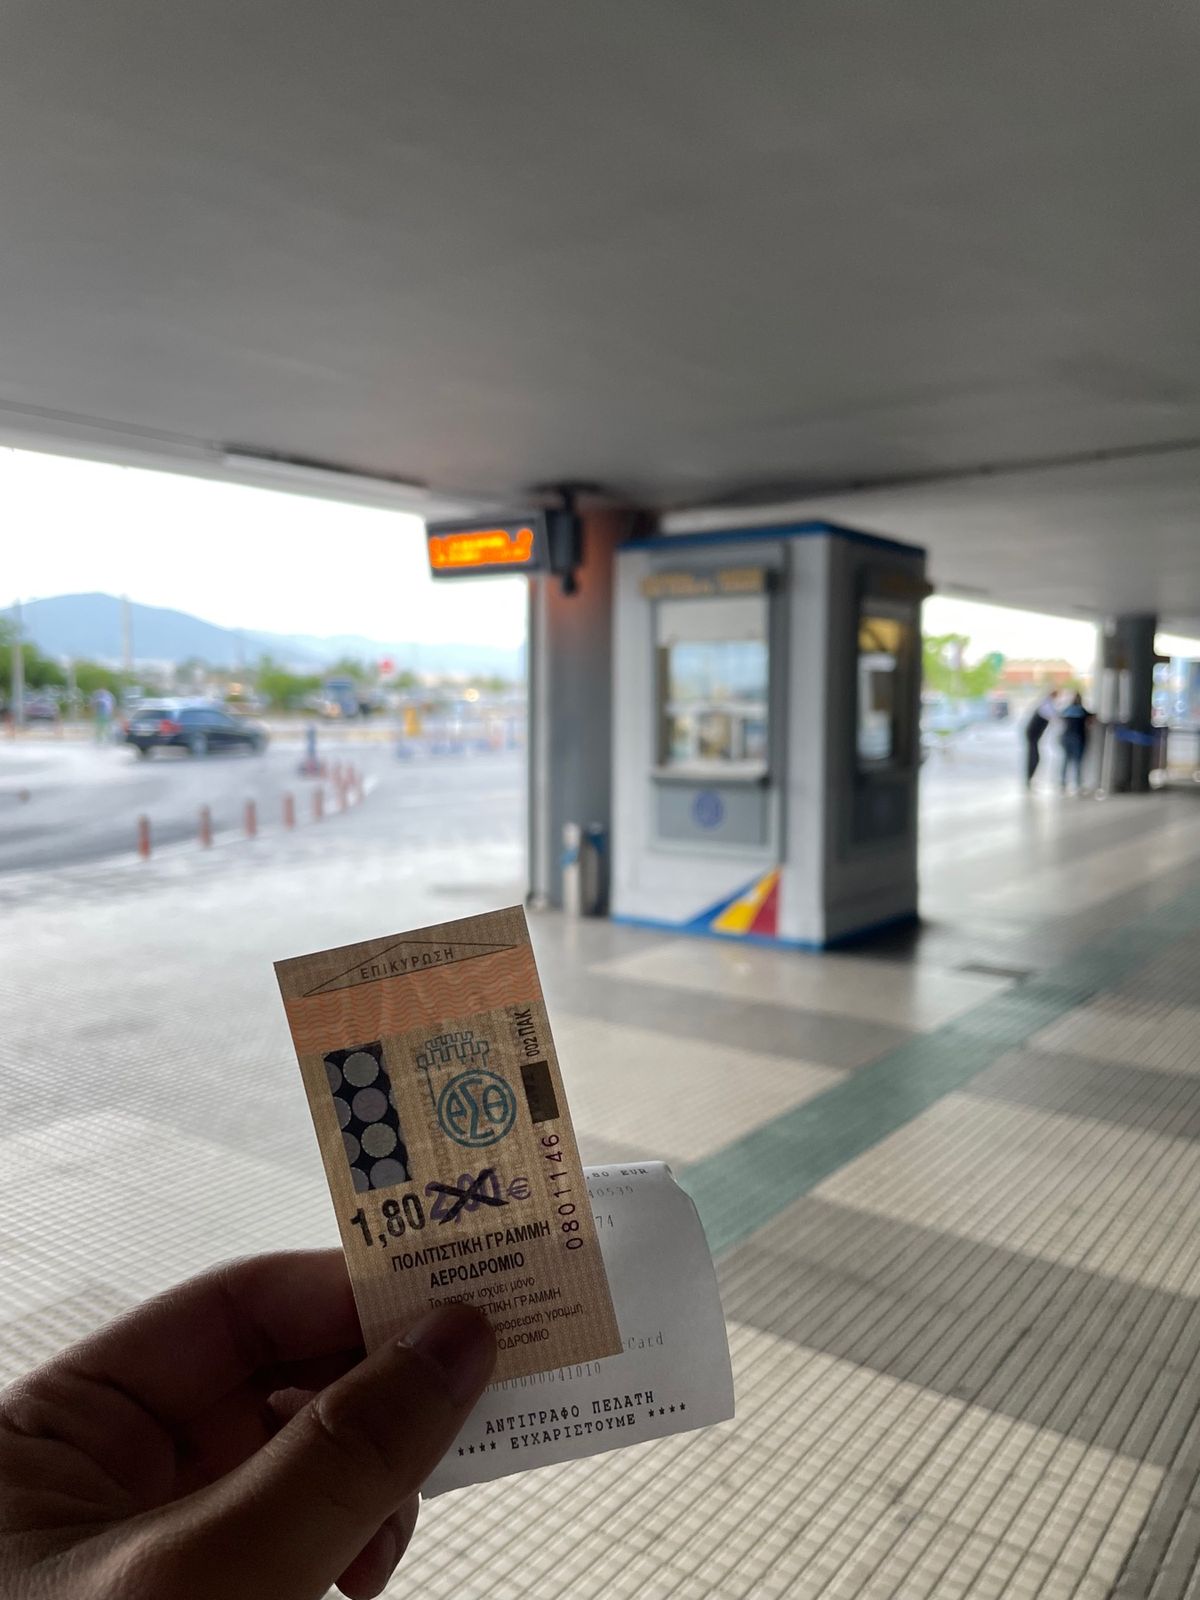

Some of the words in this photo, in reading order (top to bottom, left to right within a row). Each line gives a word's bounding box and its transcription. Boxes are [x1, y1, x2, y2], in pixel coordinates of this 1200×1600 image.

[360, 947, 454, 979] ΕΠΙΚΥΡΩΣΗ
[620, 1167, 649, 1177] EUR
[541, 1134, 583, 1250] 0801146
[351, 1193, 426, 1248] 1,80
[392, 1236, 482, 1272] ΠΟΛΙΤΙΣΤΙΚΗ
[485, 1220, 551, 1250] ΓΡΑΜΜΗ
[430, 1251, 525, 1288] ΑΕΡΟΔΡΟΜΙΟ
[478, 1281, 508, 1300] ισχύει
[511, 1276, 535, 1293] μόνο
[514, 1287, 562, 1309] ΓΡΑΜΜΗ
[545, 1301, 584, 1322] γραμμή
[497, 1328, 549, 1350] ΟΔΡΟΜΙΟ
[627, 1331, 664, 1350] Card
[486, 1405, 580, 1435] ΑΝΤΙΓΡΑΦΟ
[592, 1391, 655, 1414] ΠΕΛΑΤΗ
[510, 1413, 636, 1450] ΕΥΧΑΡΙΣΤΟΥΜΕ
